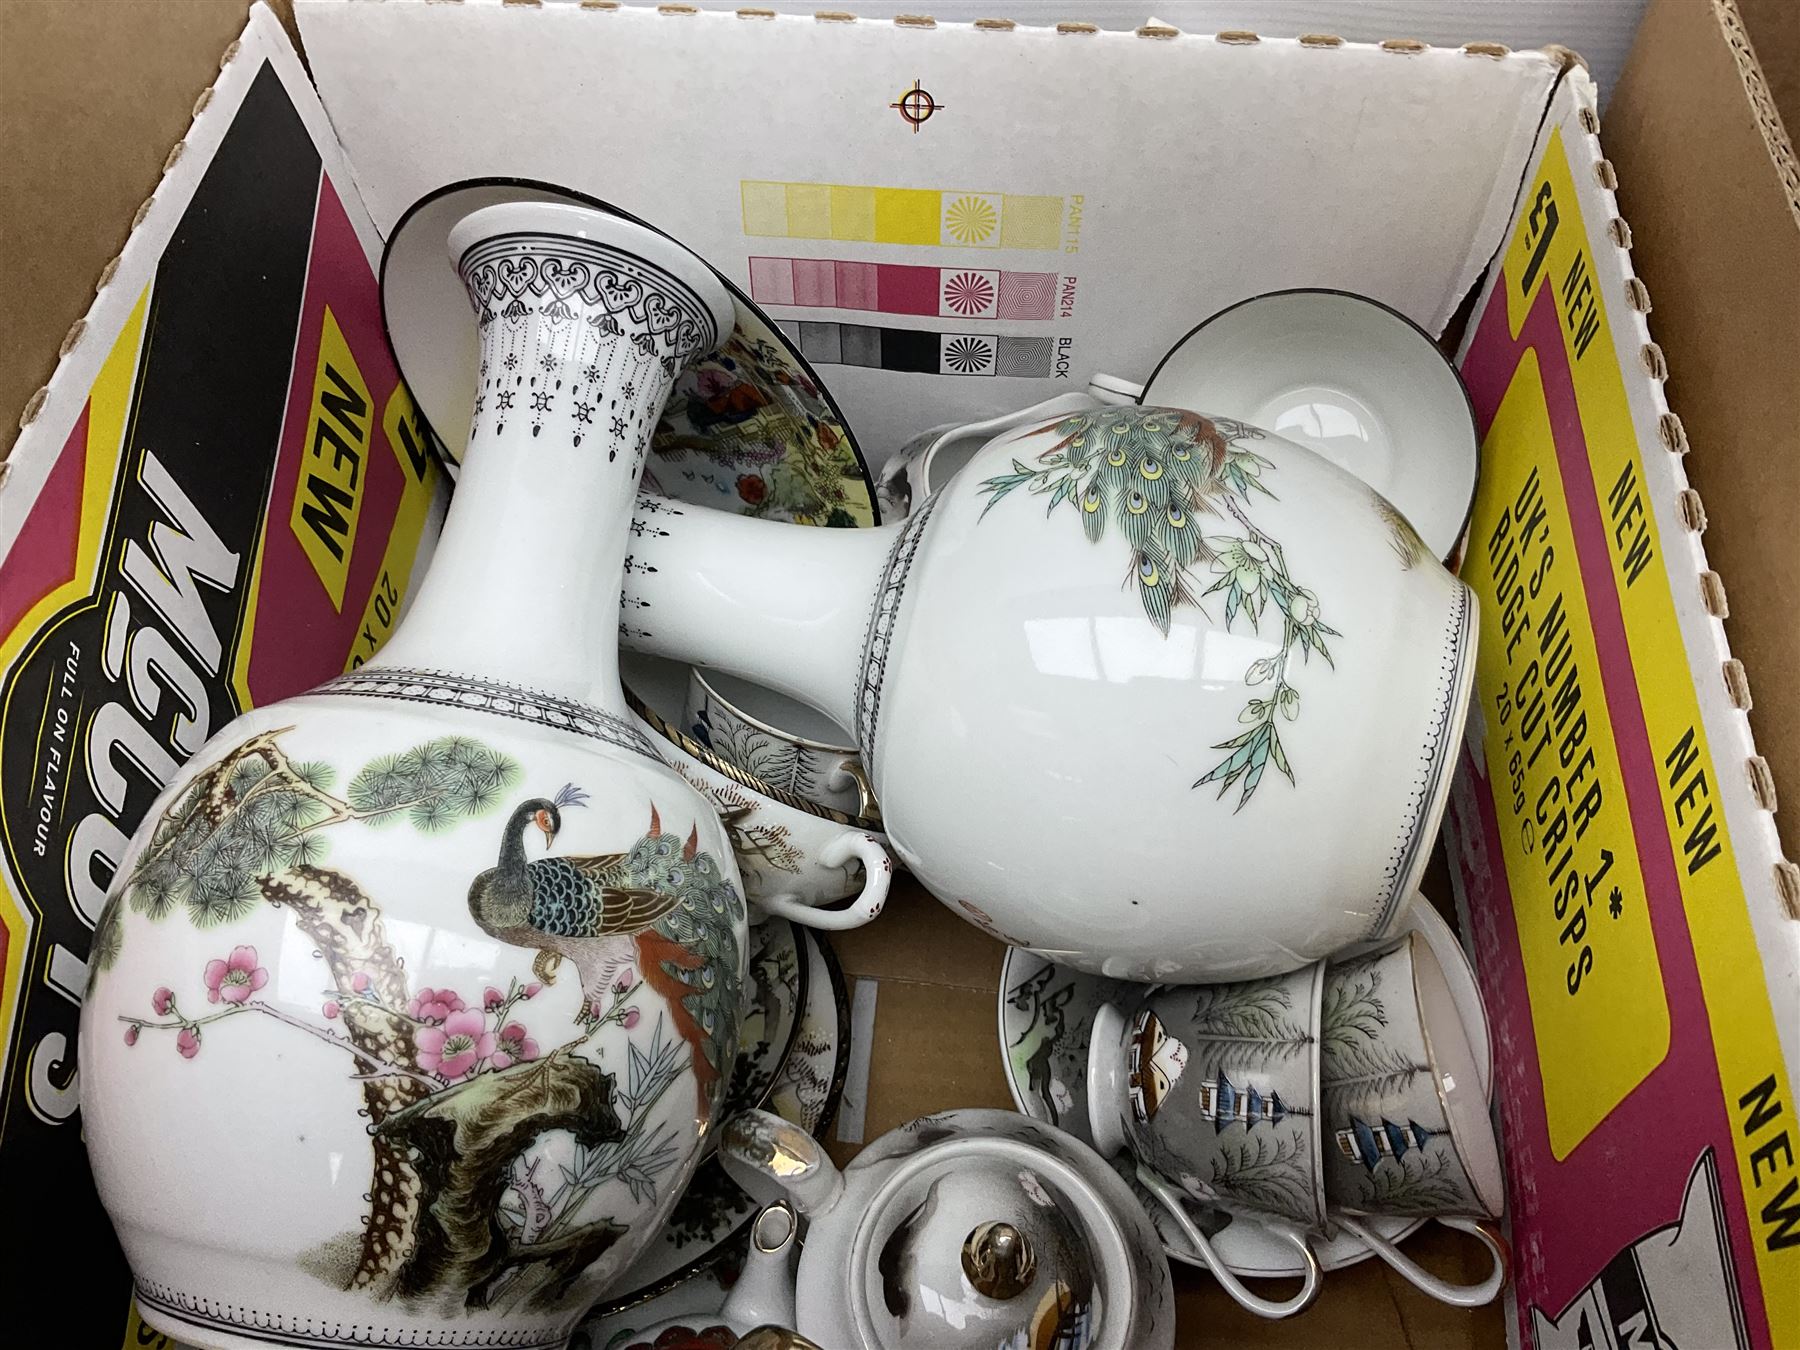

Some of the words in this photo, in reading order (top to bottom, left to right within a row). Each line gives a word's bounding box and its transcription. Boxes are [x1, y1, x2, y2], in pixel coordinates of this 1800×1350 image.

[1060, 276, 1077, 318] PAN214
[1521, 180, 1560, 298] £1
[1055, 337, 1072, 379] BLACK
[1562, 248, 1600, 361] NEW
[302, 361, 367, 565] NEW
[1608, 459, 1653, 590] NEW
[375, 570, 399, 629] 20
[1514, 465, 1554, 600] UK'S
[1537, 591, 1602, 842] NUMBER
[53, 708, 69, 743] ON
[61, 641, 81, 698] FULL
[33, 746, 62, 857] FLAVOUR
[1488, 505, 1531, 666] RIDGE
[1515, 659, 1552, 770] CUT
[1536, 775, 1594, 996] CRISPS
[1495, 682, 1512, 727] 20
[1508, 750, 1527, 816] 65g
[1665, 725, 1721, 877] NEW
[1738, 1073, 1800, 1253] NEW
